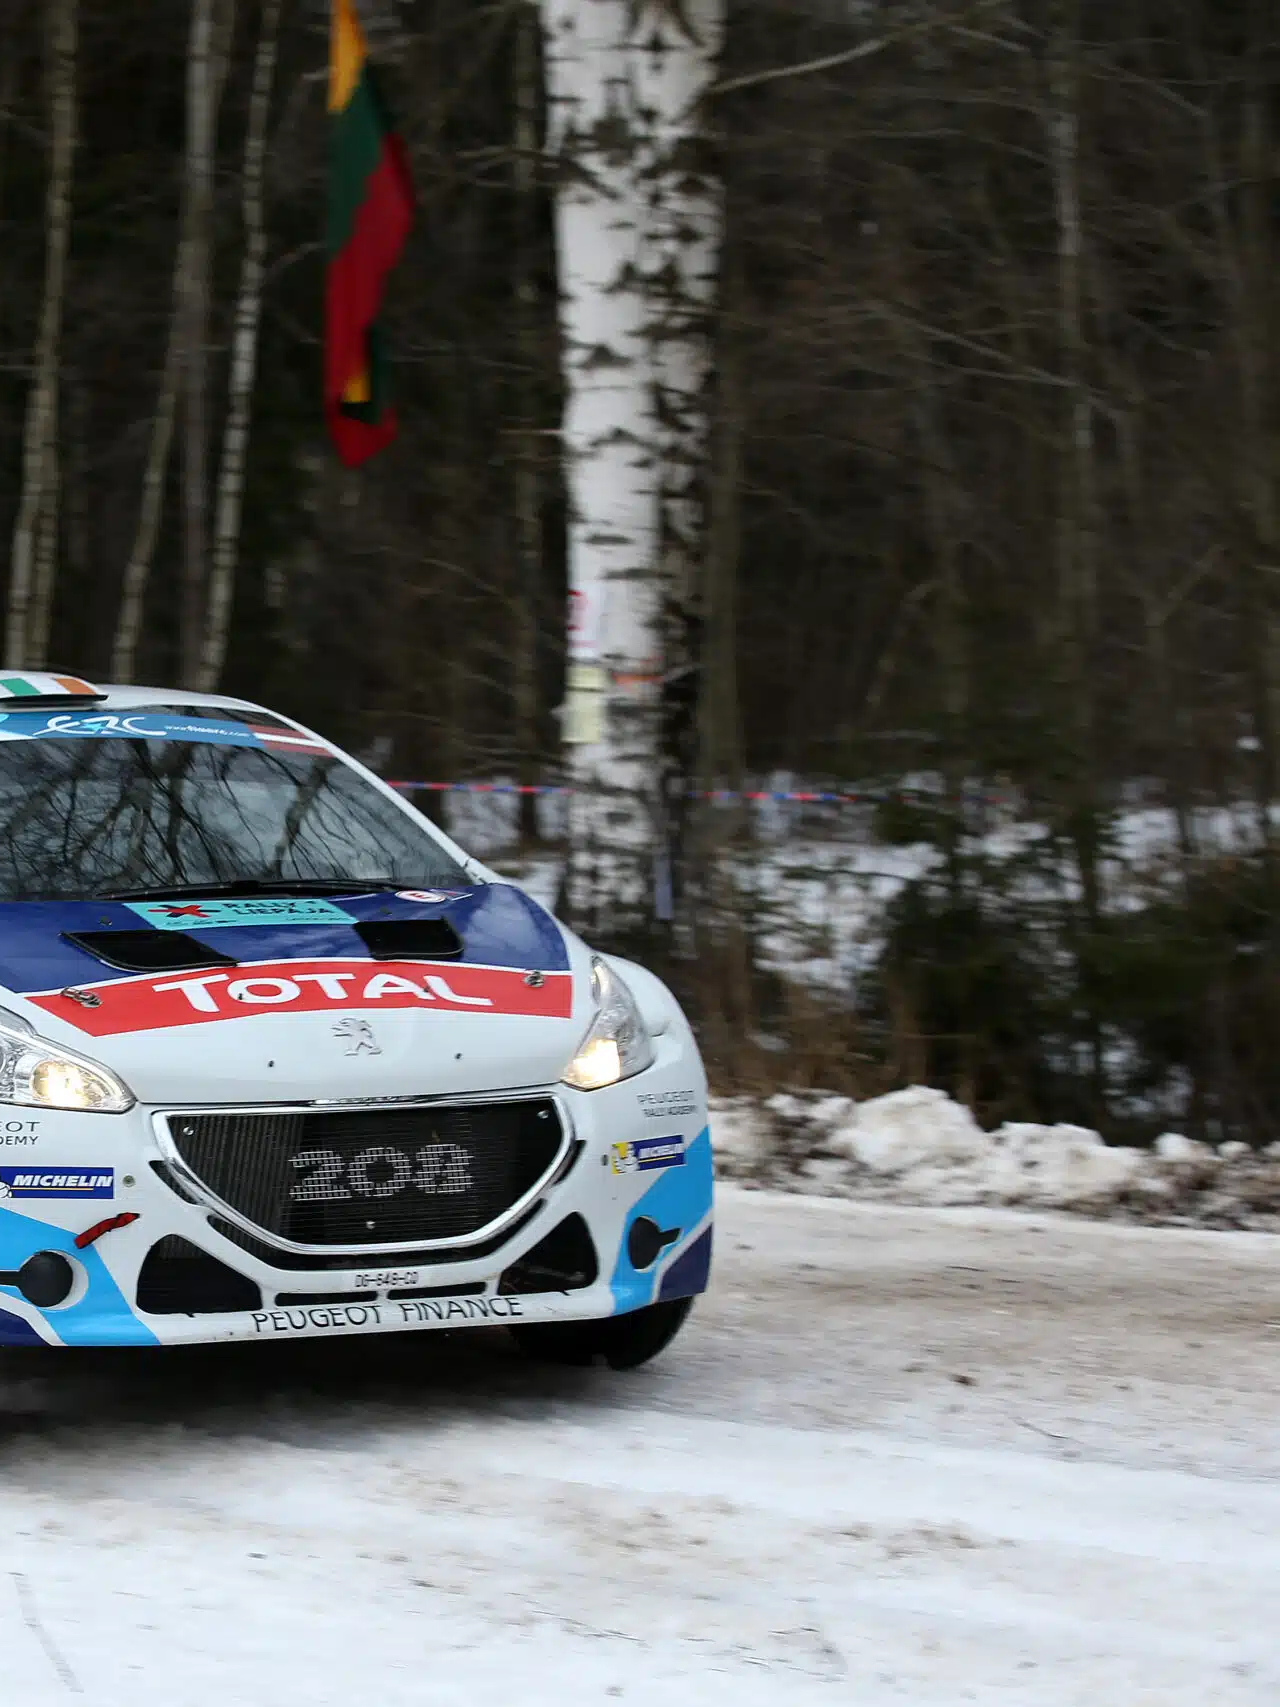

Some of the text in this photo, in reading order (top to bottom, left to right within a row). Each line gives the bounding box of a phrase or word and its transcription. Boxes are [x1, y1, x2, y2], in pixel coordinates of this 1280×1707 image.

[152, 973, 494, 1013] TOTAL
[12, 1175, 114, 1187] MICHELIN
[288, 1143, 475, 1201] 208
[251, 1297, 524, 1332] PEUGEOT FINANCE
